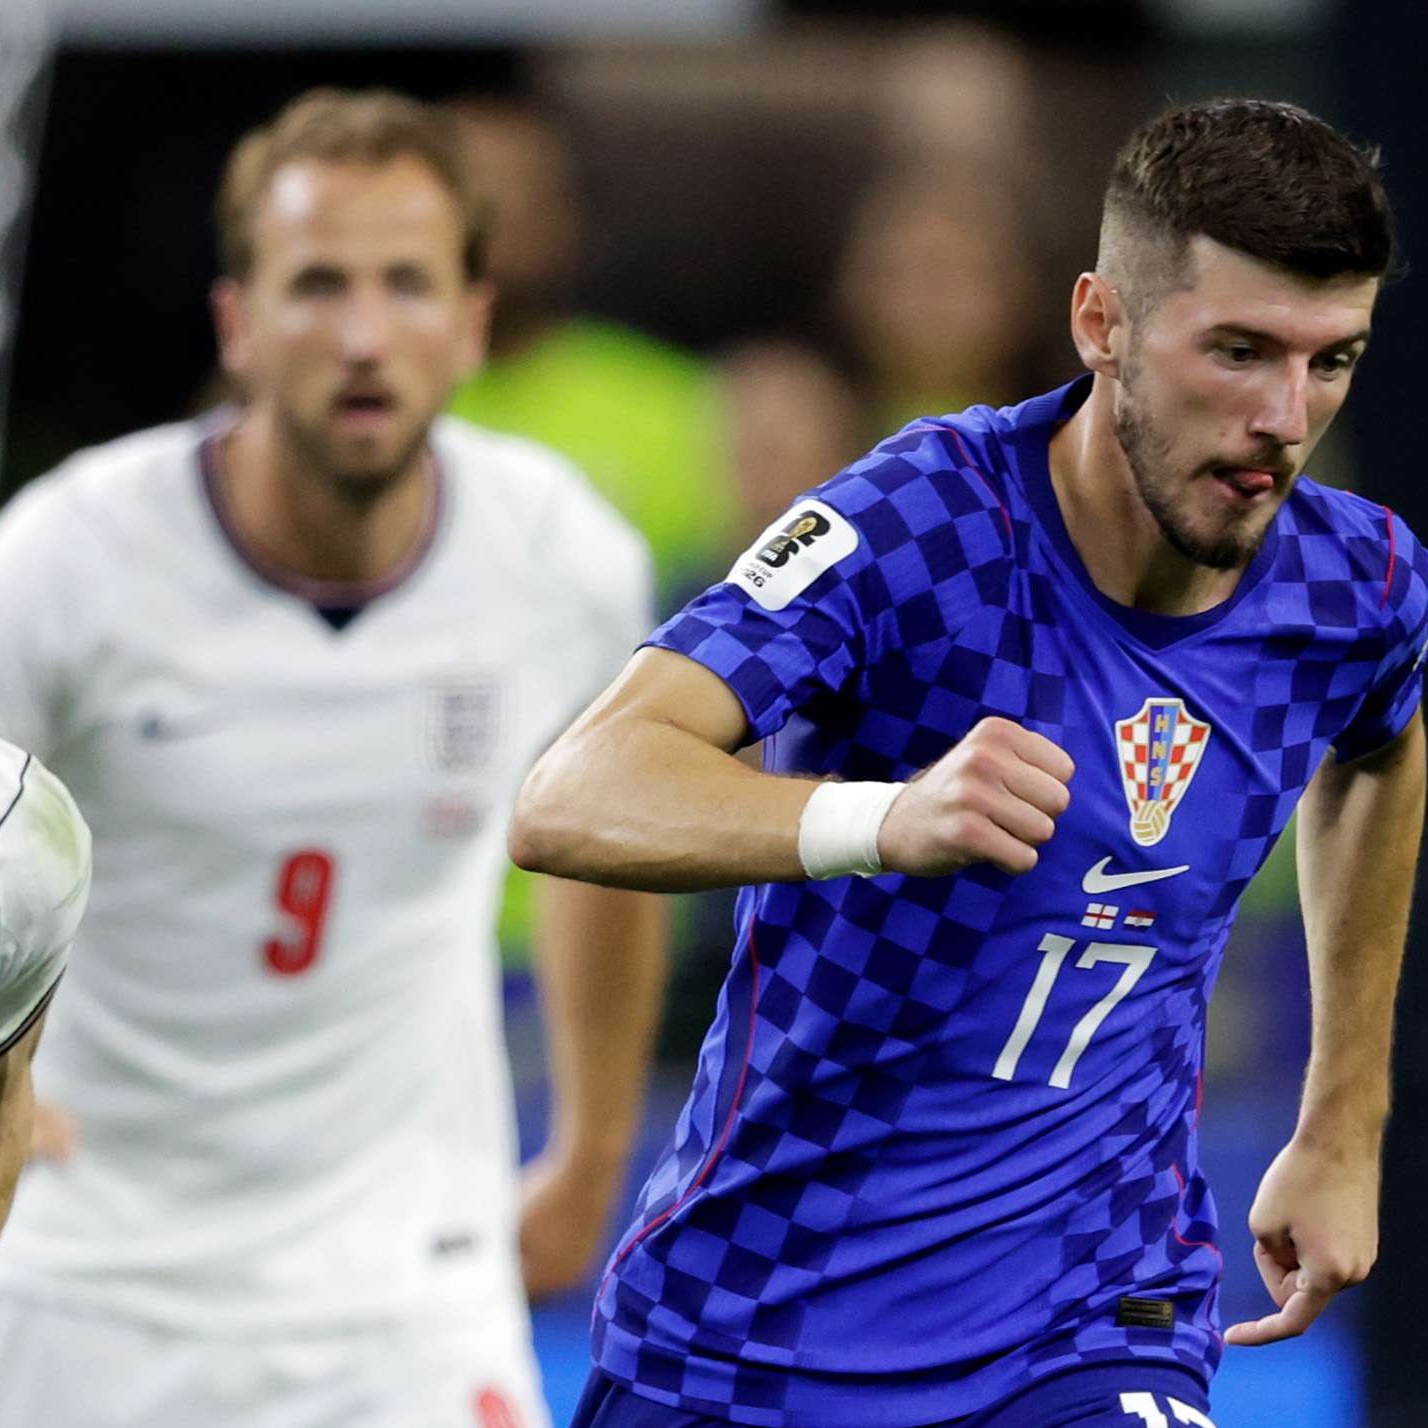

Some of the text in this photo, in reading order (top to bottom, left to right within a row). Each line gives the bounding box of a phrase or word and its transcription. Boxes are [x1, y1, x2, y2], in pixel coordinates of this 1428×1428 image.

[1150, 714, 1170, 786] HNS
[261, 848, 337, 978] 9
[992, 932, 1157, 1089] 17
